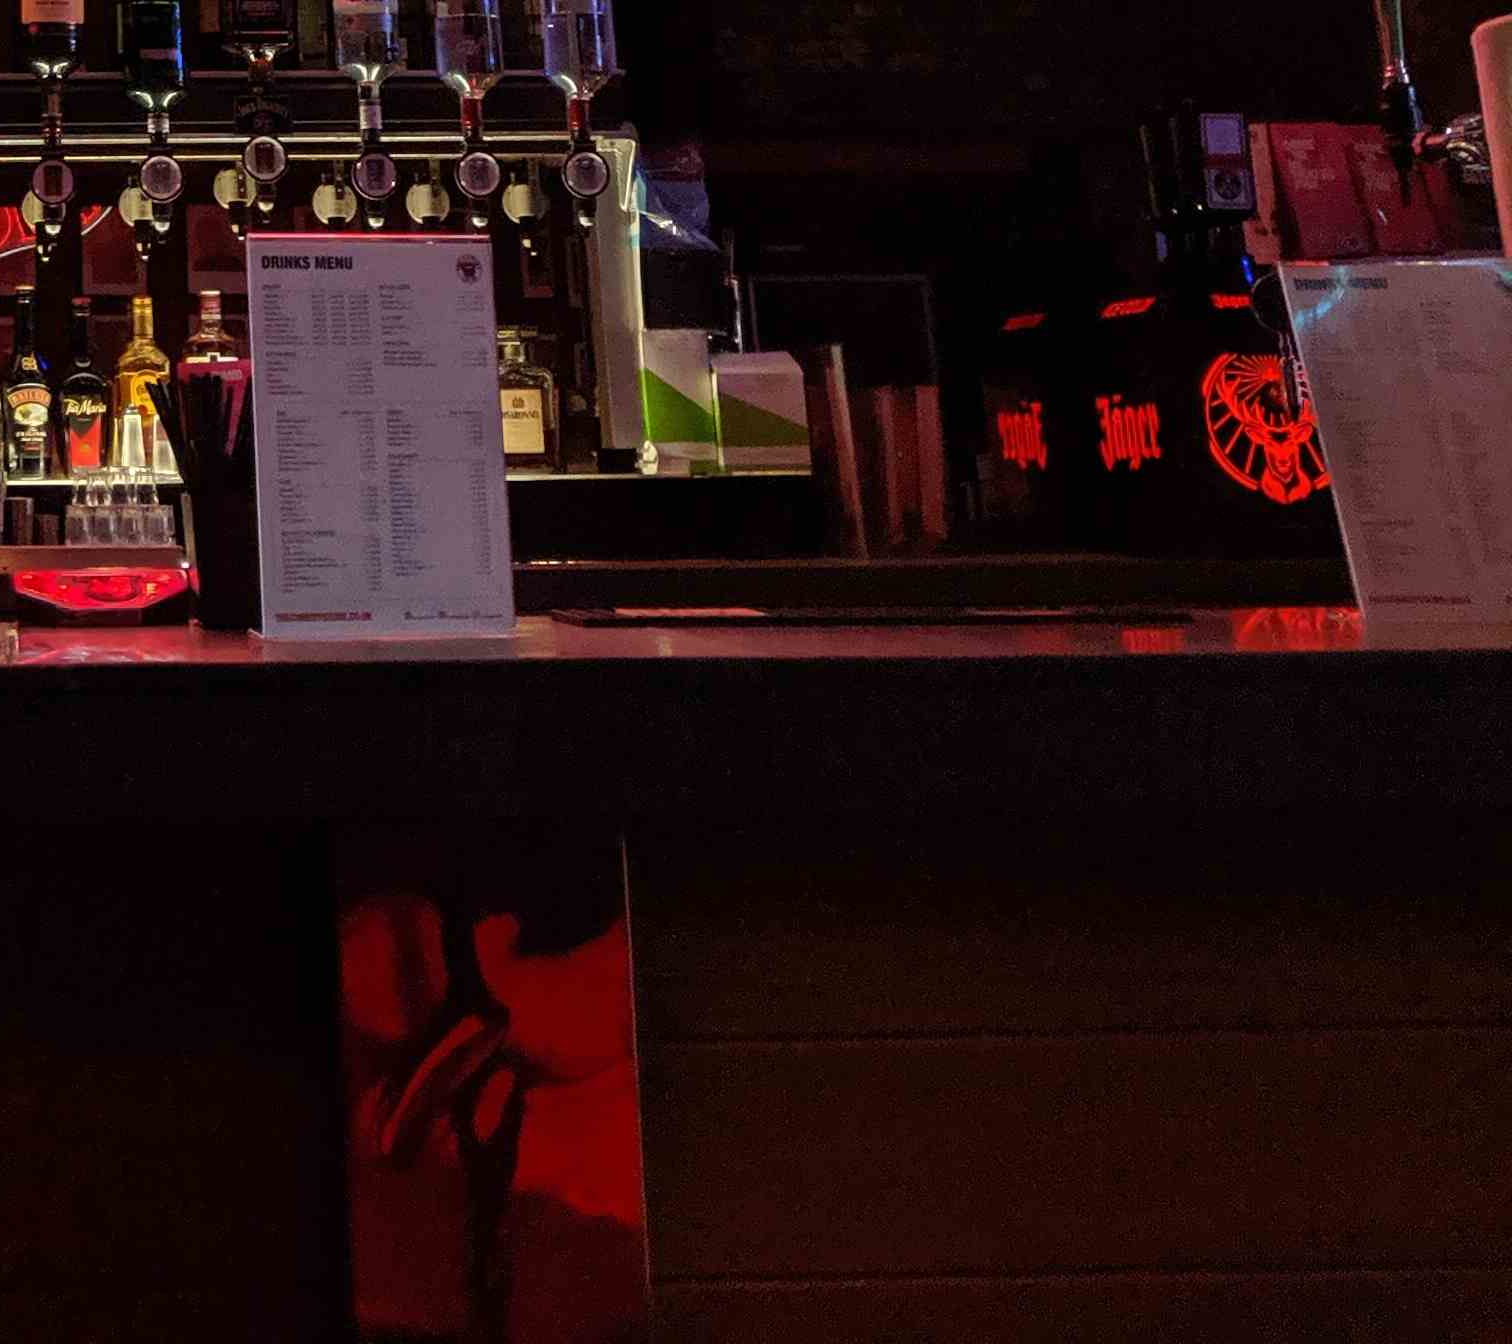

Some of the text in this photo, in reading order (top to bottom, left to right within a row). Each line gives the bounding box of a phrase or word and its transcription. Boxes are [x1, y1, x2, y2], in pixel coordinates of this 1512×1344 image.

[261, 255, 353, 270] DRINKS MENU
[1293, 277, 1339, 291] DRINK
